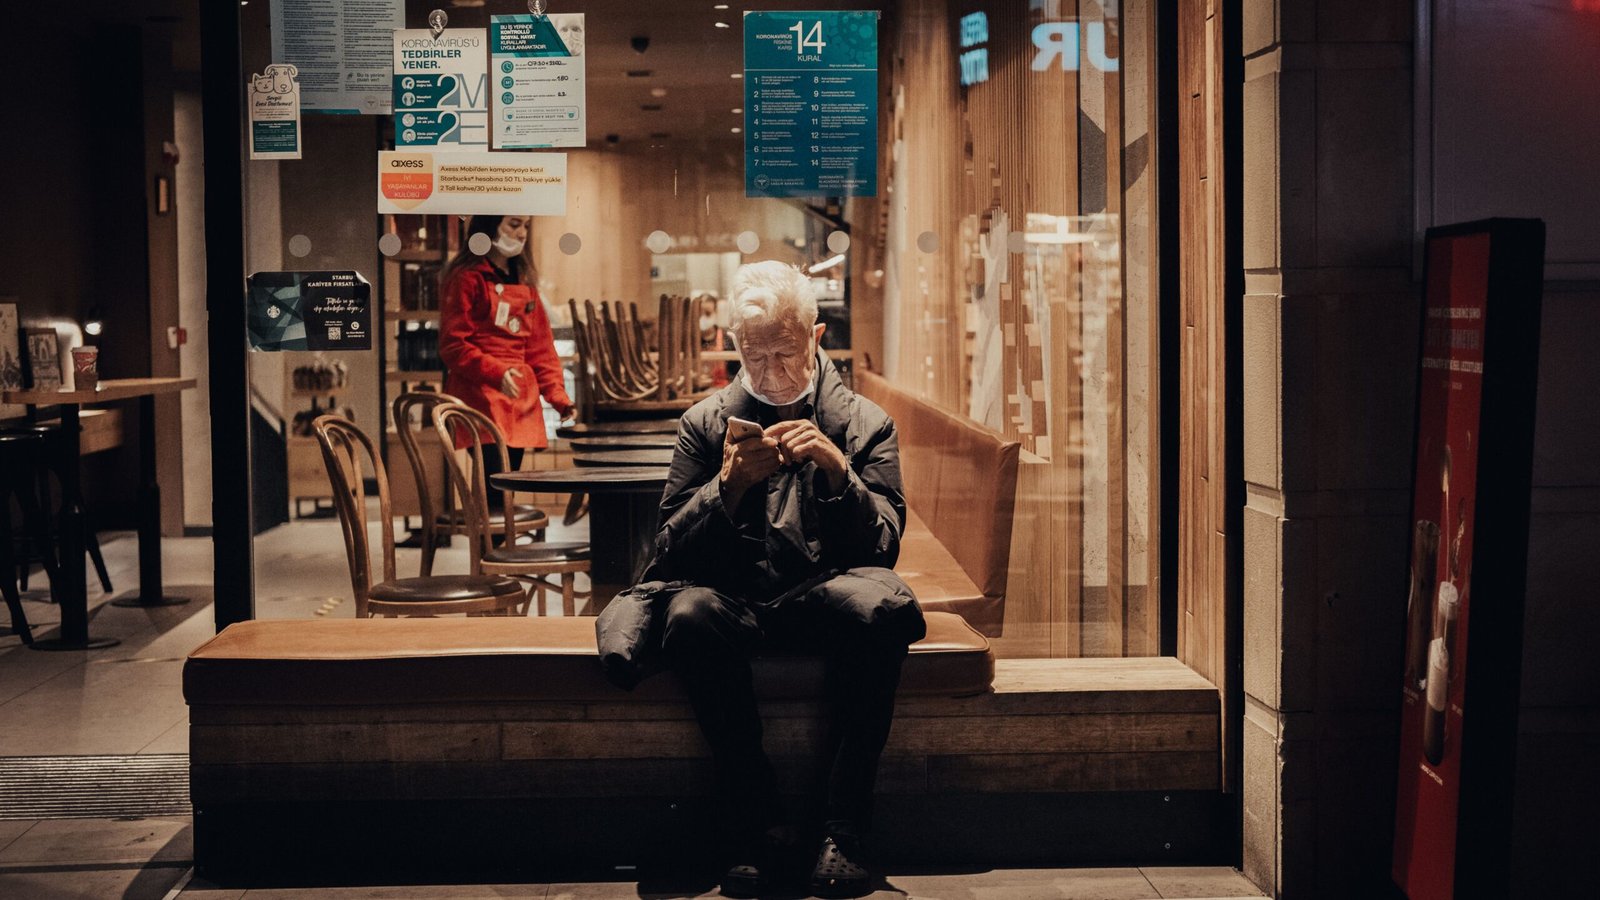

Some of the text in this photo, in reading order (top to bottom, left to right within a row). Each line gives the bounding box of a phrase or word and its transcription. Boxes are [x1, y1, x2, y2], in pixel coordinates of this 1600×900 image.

[789, 21, 826, 54] 14
[401, 37, 479, 48] KORONAVİRÜS'Ü
[401, 48, 461, 58] TEDBİRLER
[402, 60, 440, 69] YENER.
[814, 76, 819, 84] 8
[754, 104, 759, 112] 3
[811, 159, 819, 167] 14
